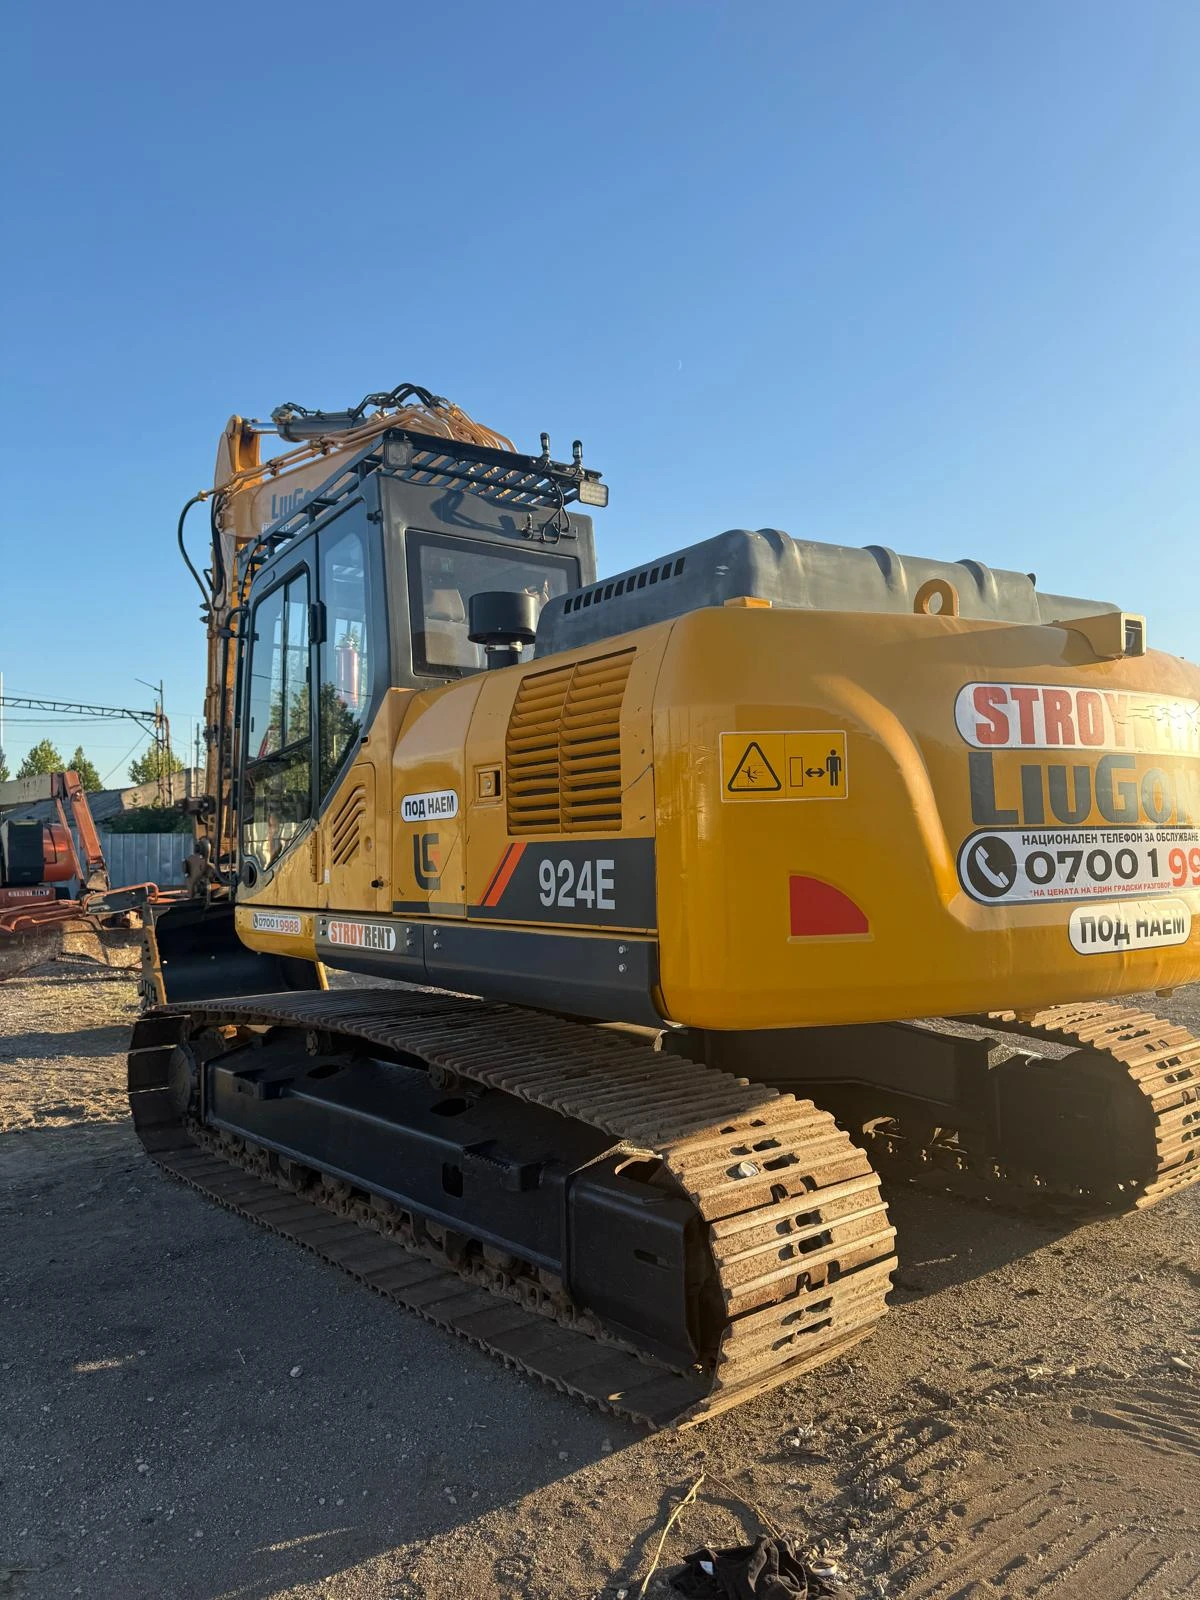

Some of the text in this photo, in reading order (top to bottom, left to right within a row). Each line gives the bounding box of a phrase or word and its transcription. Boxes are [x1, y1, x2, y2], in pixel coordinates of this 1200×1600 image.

[972, 686, 1200, 752] STROY
[404, 795, 455, 818] ПОД НАЕМ
[1021, 832, 1200, 846] НАЦИОНАЛЕН ТЕЛЕФОН ЗА ОБСЛУЖВАНЕ
[538, 858, 616, 910] 924E
[1047, 887, 1079, 899] ЦЕНАТА
[1093, 886, 1112, 894] ЕДИН
[1113, 883, 1143, 893] ГРАДСКИ
[1143, 881, 1170, 890] РАЗГОВОР
[331, 920, 392, 950] STROYRENT
[1079, 911, 1185, 946] ПОД НАЕМ
